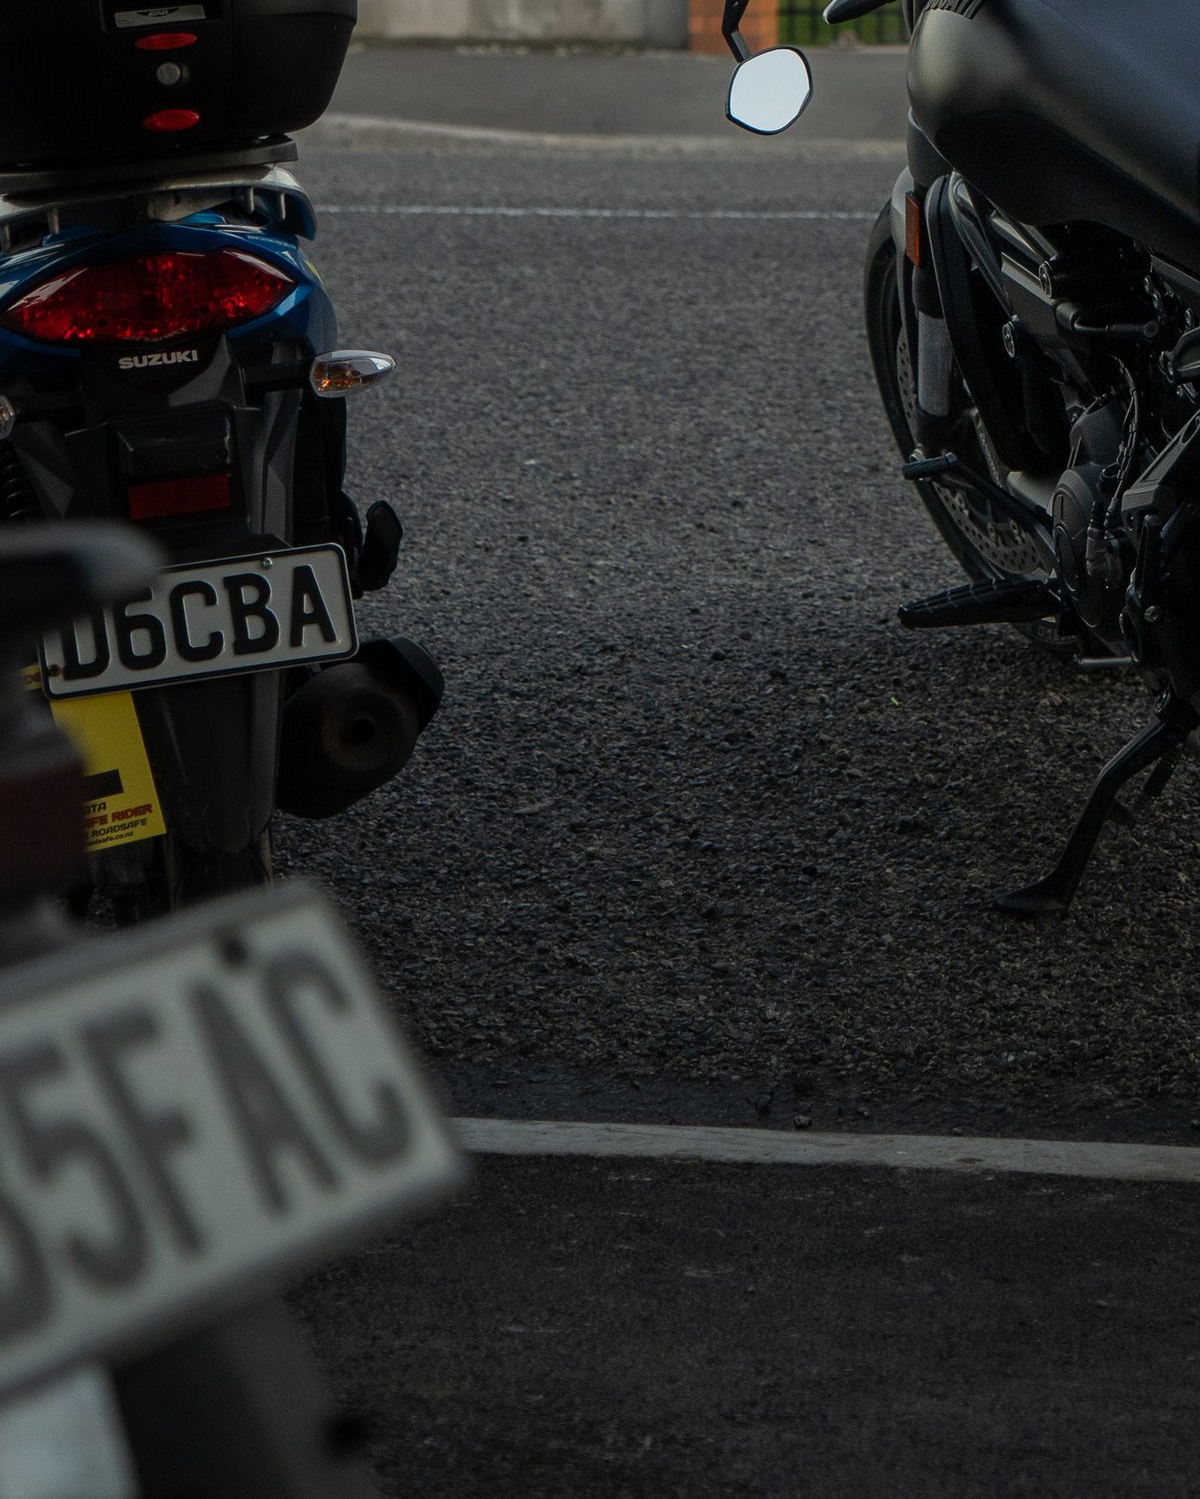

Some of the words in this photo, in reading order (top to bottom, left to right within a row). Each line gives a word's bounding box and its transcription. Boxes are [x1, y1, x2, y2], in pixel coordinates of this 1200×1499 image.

[118, 349, 198, 370] SUZUKI
[111, 804, 153, 822] RIDER
[91, 818, 147, 837] ROADSAFE
